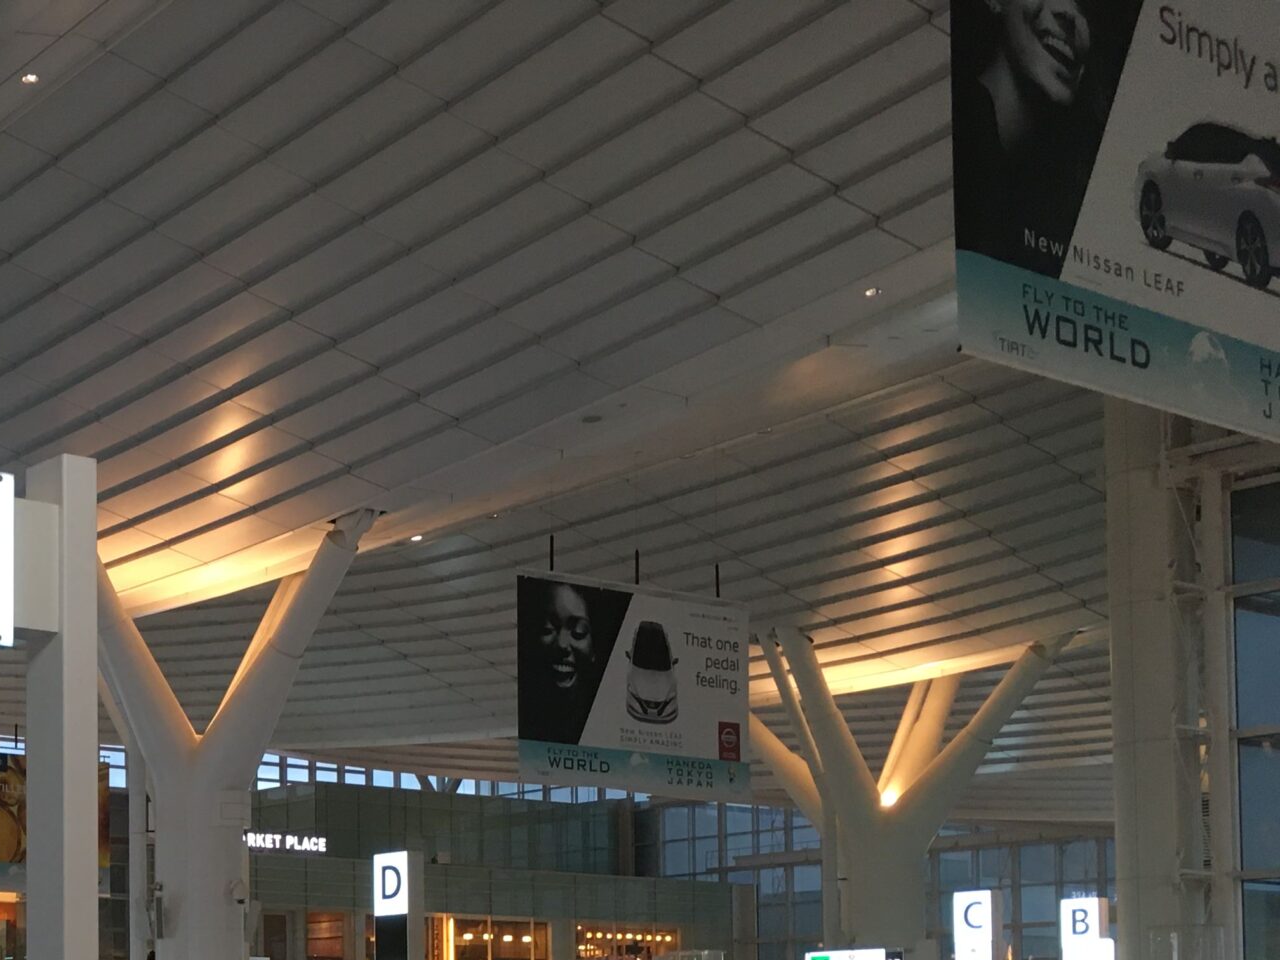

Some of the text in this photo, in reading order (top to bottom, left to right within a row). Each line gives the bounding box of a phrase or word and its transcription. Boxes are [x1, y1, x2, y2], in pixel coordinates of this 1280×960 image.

[1159, 5, 1256, 89] Simply
[1024, 228, 1185, 297] New Nissan LEAF
[1022, 283, 1128, 331] FLY TO THE
[1023, 304, 1150, 369] WORLD
[683, 632, 739, 653] That one
[705, 657, 739, 672] pedal
[696, 671, 740, 695] feeling.
[548, 755, 610, 773] WORLD
[666, 758, 712, 769] HANEDA
[667, 768, 713, 779] TOKYO
[667, 778, 713, 788] JAPAN
[242, 832, 327, 852] RKET PLACE
[382, 865, 401, 900] D
[963, 902, 983, 929] C
[1072, 909, 1090, 935] B
